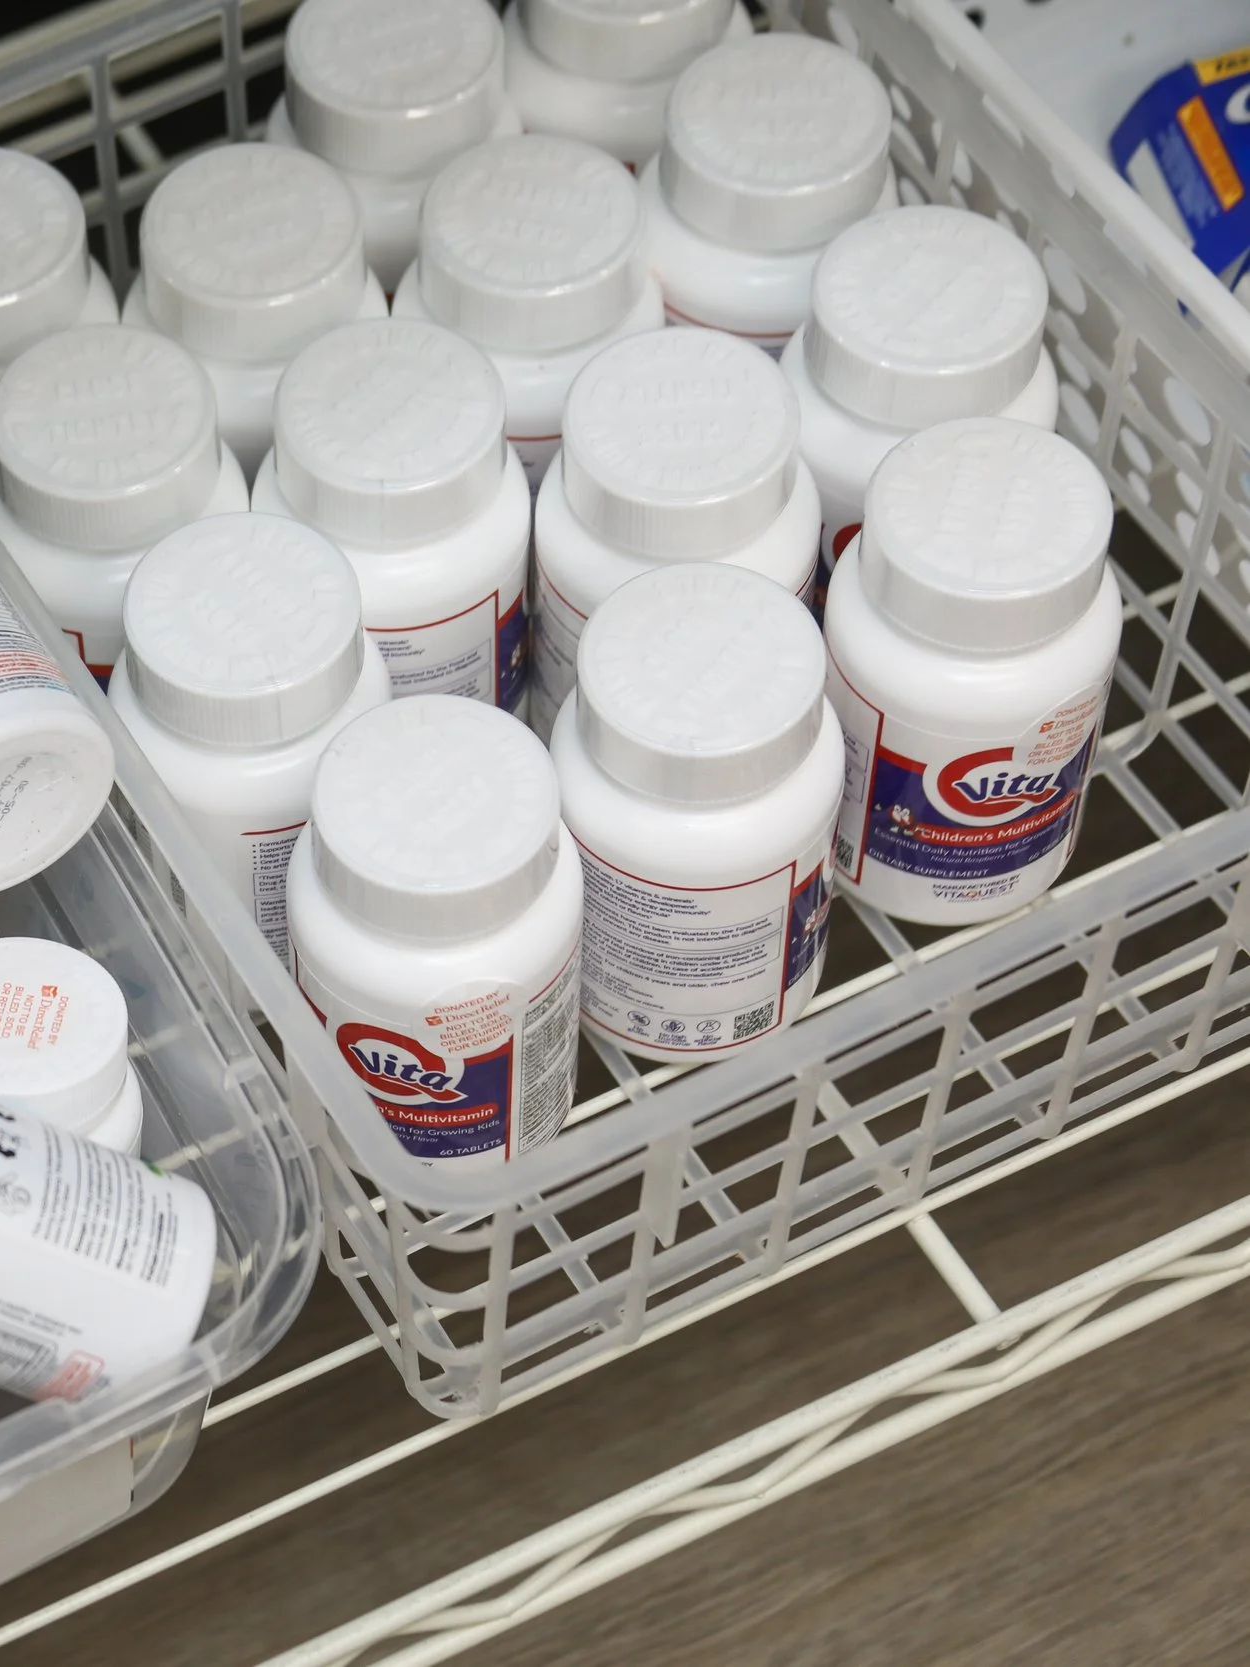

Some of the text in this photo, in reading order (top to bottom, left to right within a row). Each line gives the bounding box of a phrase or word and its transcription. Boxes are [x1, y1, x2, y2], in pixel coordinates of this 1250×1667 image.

[953, 769, 1057, 803] Vita
[875, 825, 919, 850] Essential
[922, 845, 949, 856] Daily
[921, 829, 993, 842] Children's
[866, 849, 987, 877] DIETARY SUPPLEMENT
[616, 886, 639, 898] growth
[625, 885, 651, 896] vitamins
[723, 949, 752, 959] products
[738, 953, 767, 966] overdose
[1, 983, 11, 995] OR
[24, 995, 34, 1012] NOT
[434, 998, 484, 1014] DONATED
[446, 995, 509, 1022] Direct Relief
[51, 997, 68, 1033] DONATED
[14, 1024, 25, 1035] BE
[28, 999, 52, 1049] Direct Relief
[457, 1018, 512, 1043] RETURNED
[448, 1043, 470, 1053] FOR
[349, 1045, 454, 1091] Vita
[400, 1109, 493, 1122] Multivitamin
[457, 1139, 501, 1154] TABLETS
